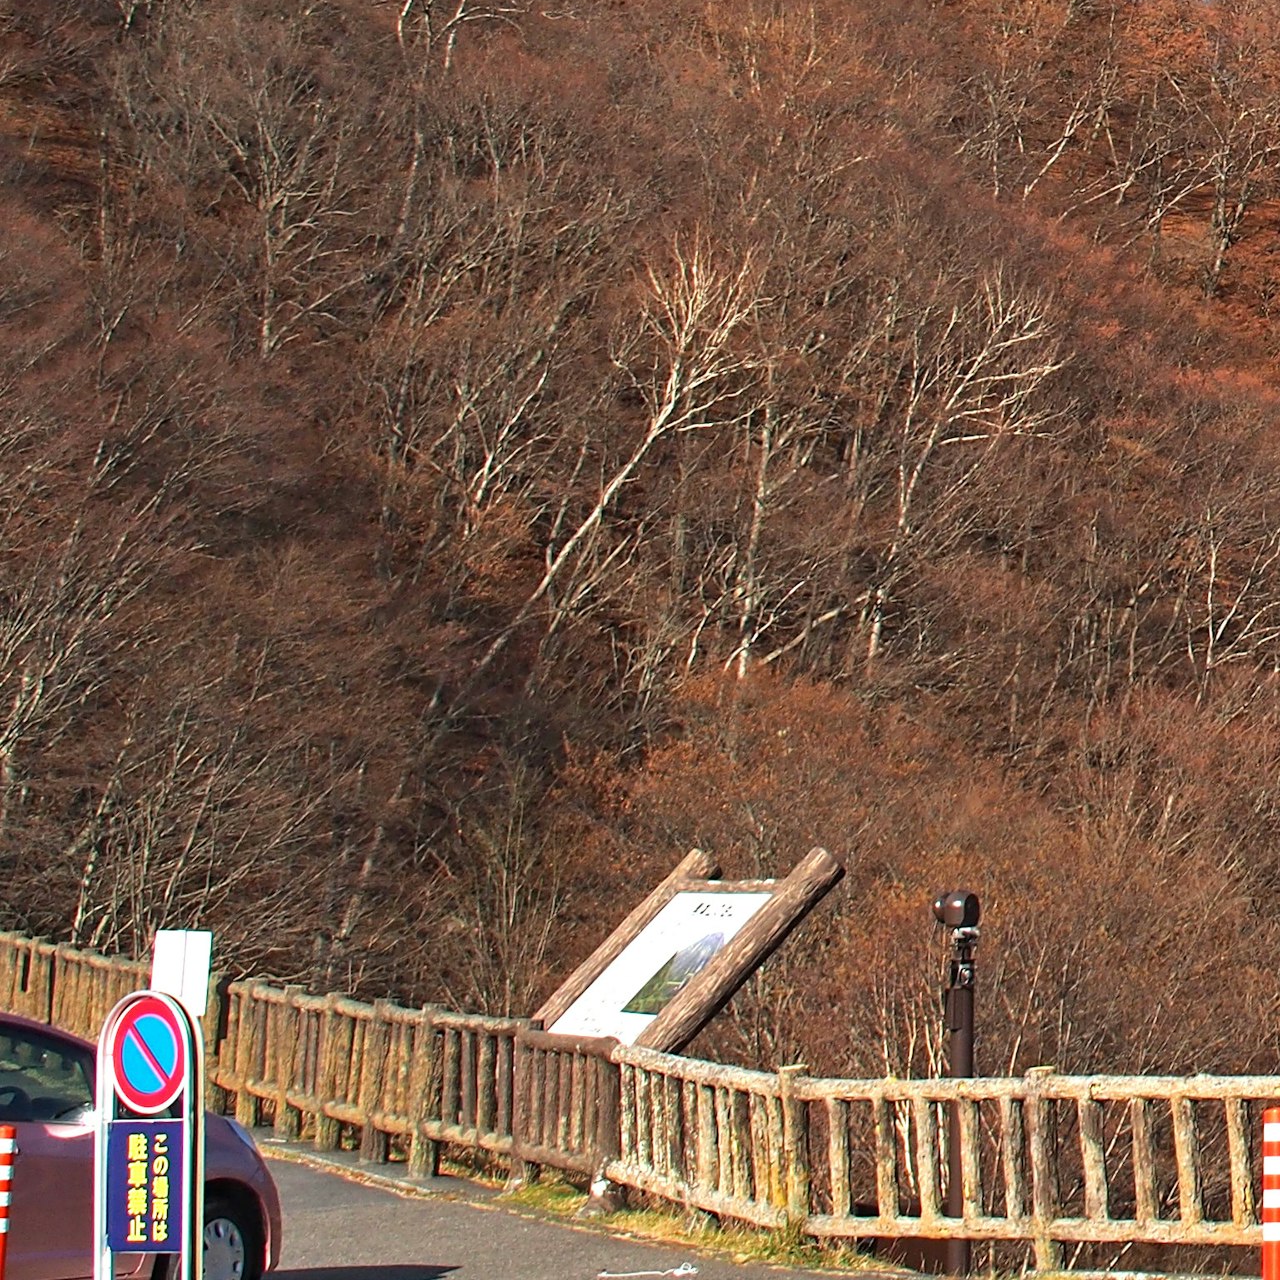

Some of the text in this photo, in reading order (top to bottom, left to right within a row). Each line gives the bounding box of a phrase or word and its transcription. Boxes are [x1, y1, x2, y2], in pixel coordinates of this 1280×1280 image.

[126, 1133, 149, 1242] 駐車禁止
[152, 1133, 170, 1242] この場所は
